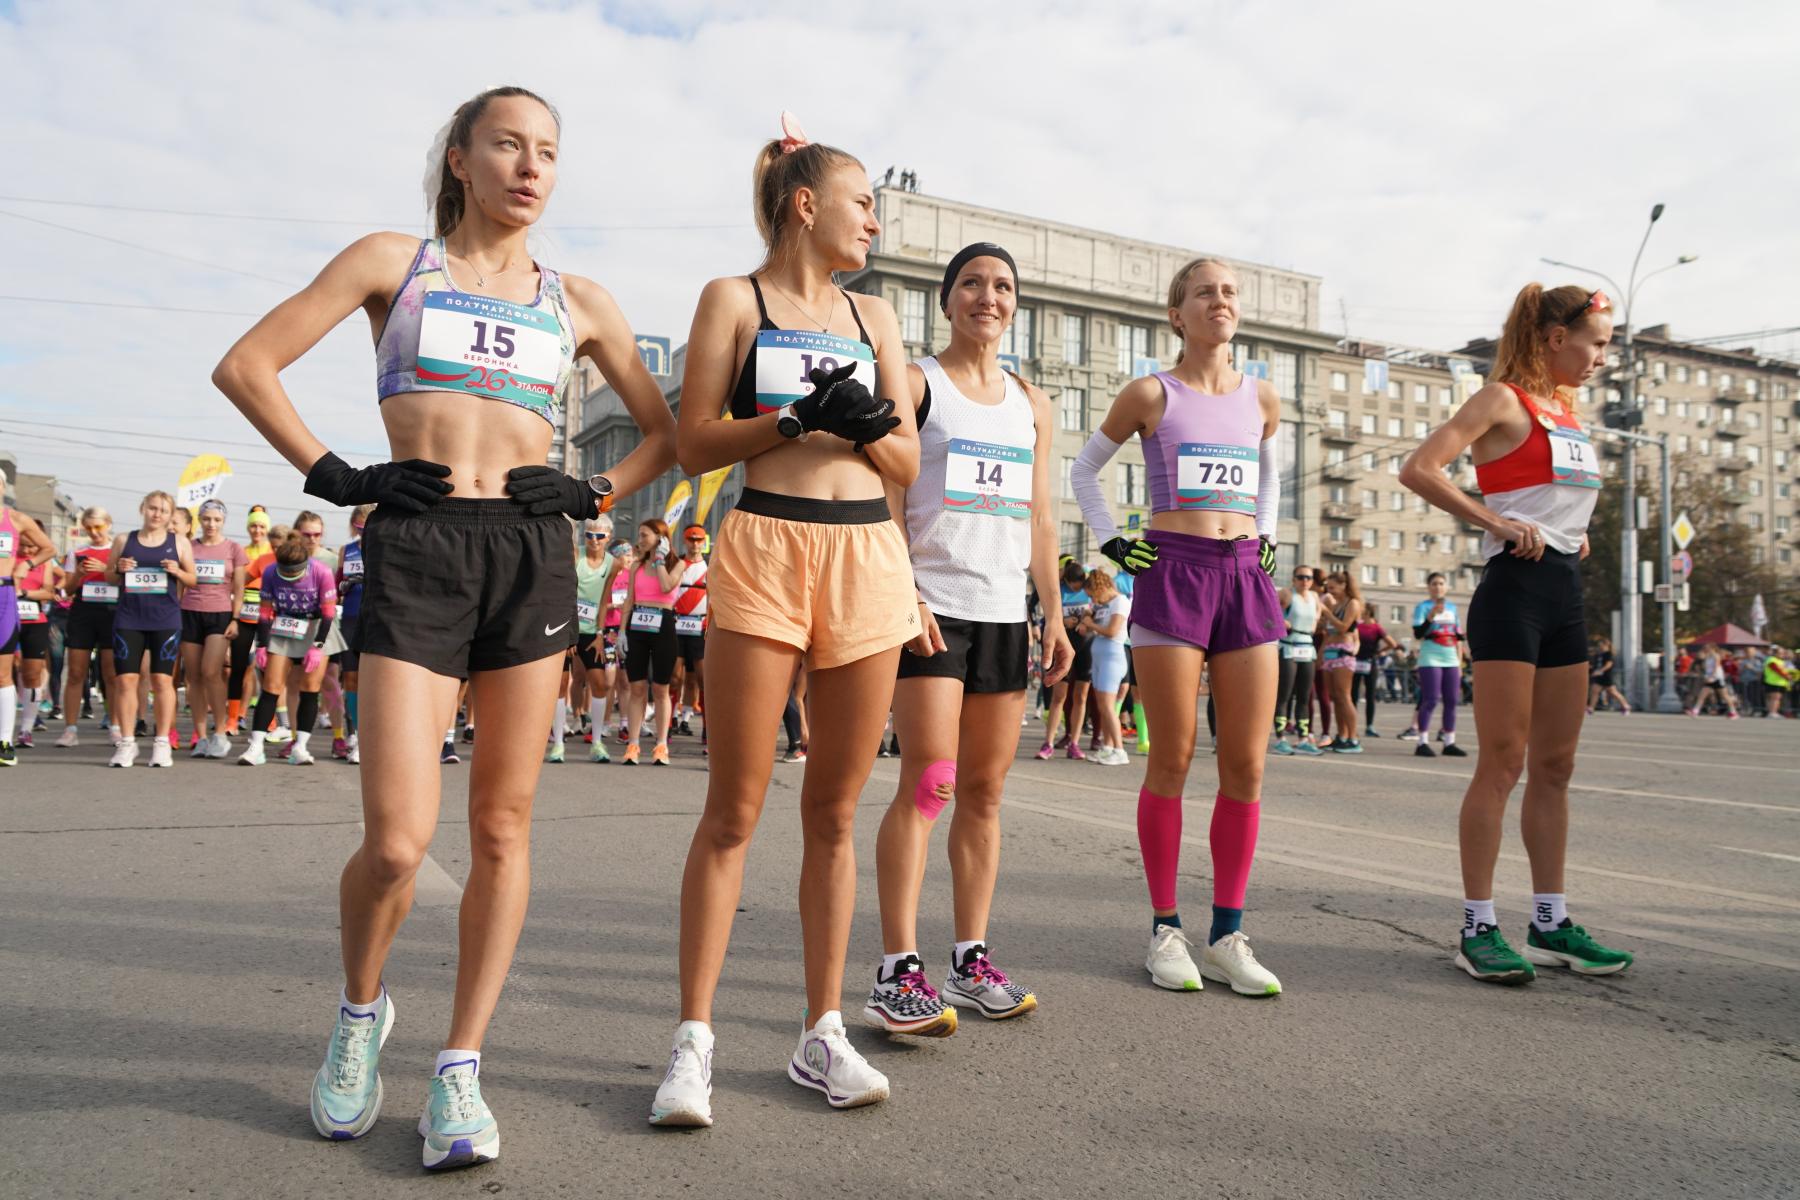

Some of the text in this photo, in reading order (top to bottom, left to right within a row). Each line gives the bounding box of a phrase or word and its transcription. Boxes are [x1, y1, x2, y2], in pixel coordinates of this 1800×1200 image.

[446, 297, 537, 322] ПОЛУМАРАФОН
[470, 320, 516, 359] 15
[776, 335, 854, 352] ПОЛУМАРАФОН
[463, 353, 519, 369] ВЕРОНИКА
[464, 365, 510, 391] 26
[516, 381, 549, 396] ЭТАЛОН
[961, 444, 1017, 458] ПОЛУМАРАФОН
[1567, 441, 1584, 463] 12
[975, 461, 1003, 487] 14
[1199, 462, 1243, 487] 720
[135, 574, 158, 583] 503
[196, 566, 215, 575] 971
[577, 606, 589, 615] 74
[638, 614, 655, 623] 437
[280, 619, 299, 628] 554
[680, 621, 696, 629] 766
[1537, 902, 1552, 923] GRI
